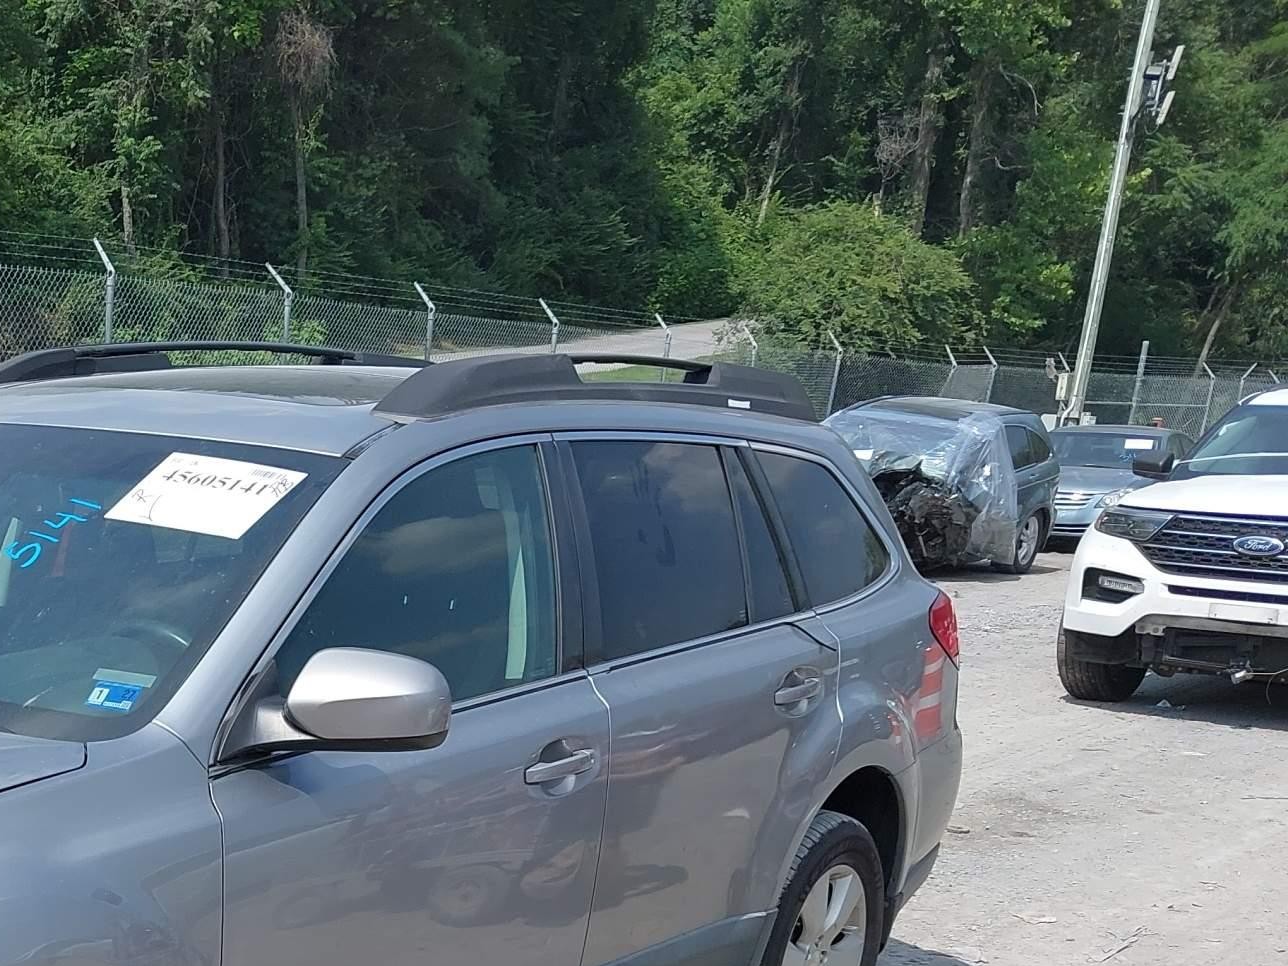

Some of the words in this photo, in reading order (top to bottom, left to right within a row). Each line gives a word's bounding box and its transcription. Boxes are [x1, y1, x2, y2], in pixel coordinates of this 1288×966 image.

[162, 469, 269, 495] 45605141
[4, 498, 102, 568] 5141
[1244, 539, 1273, 551] Ford
